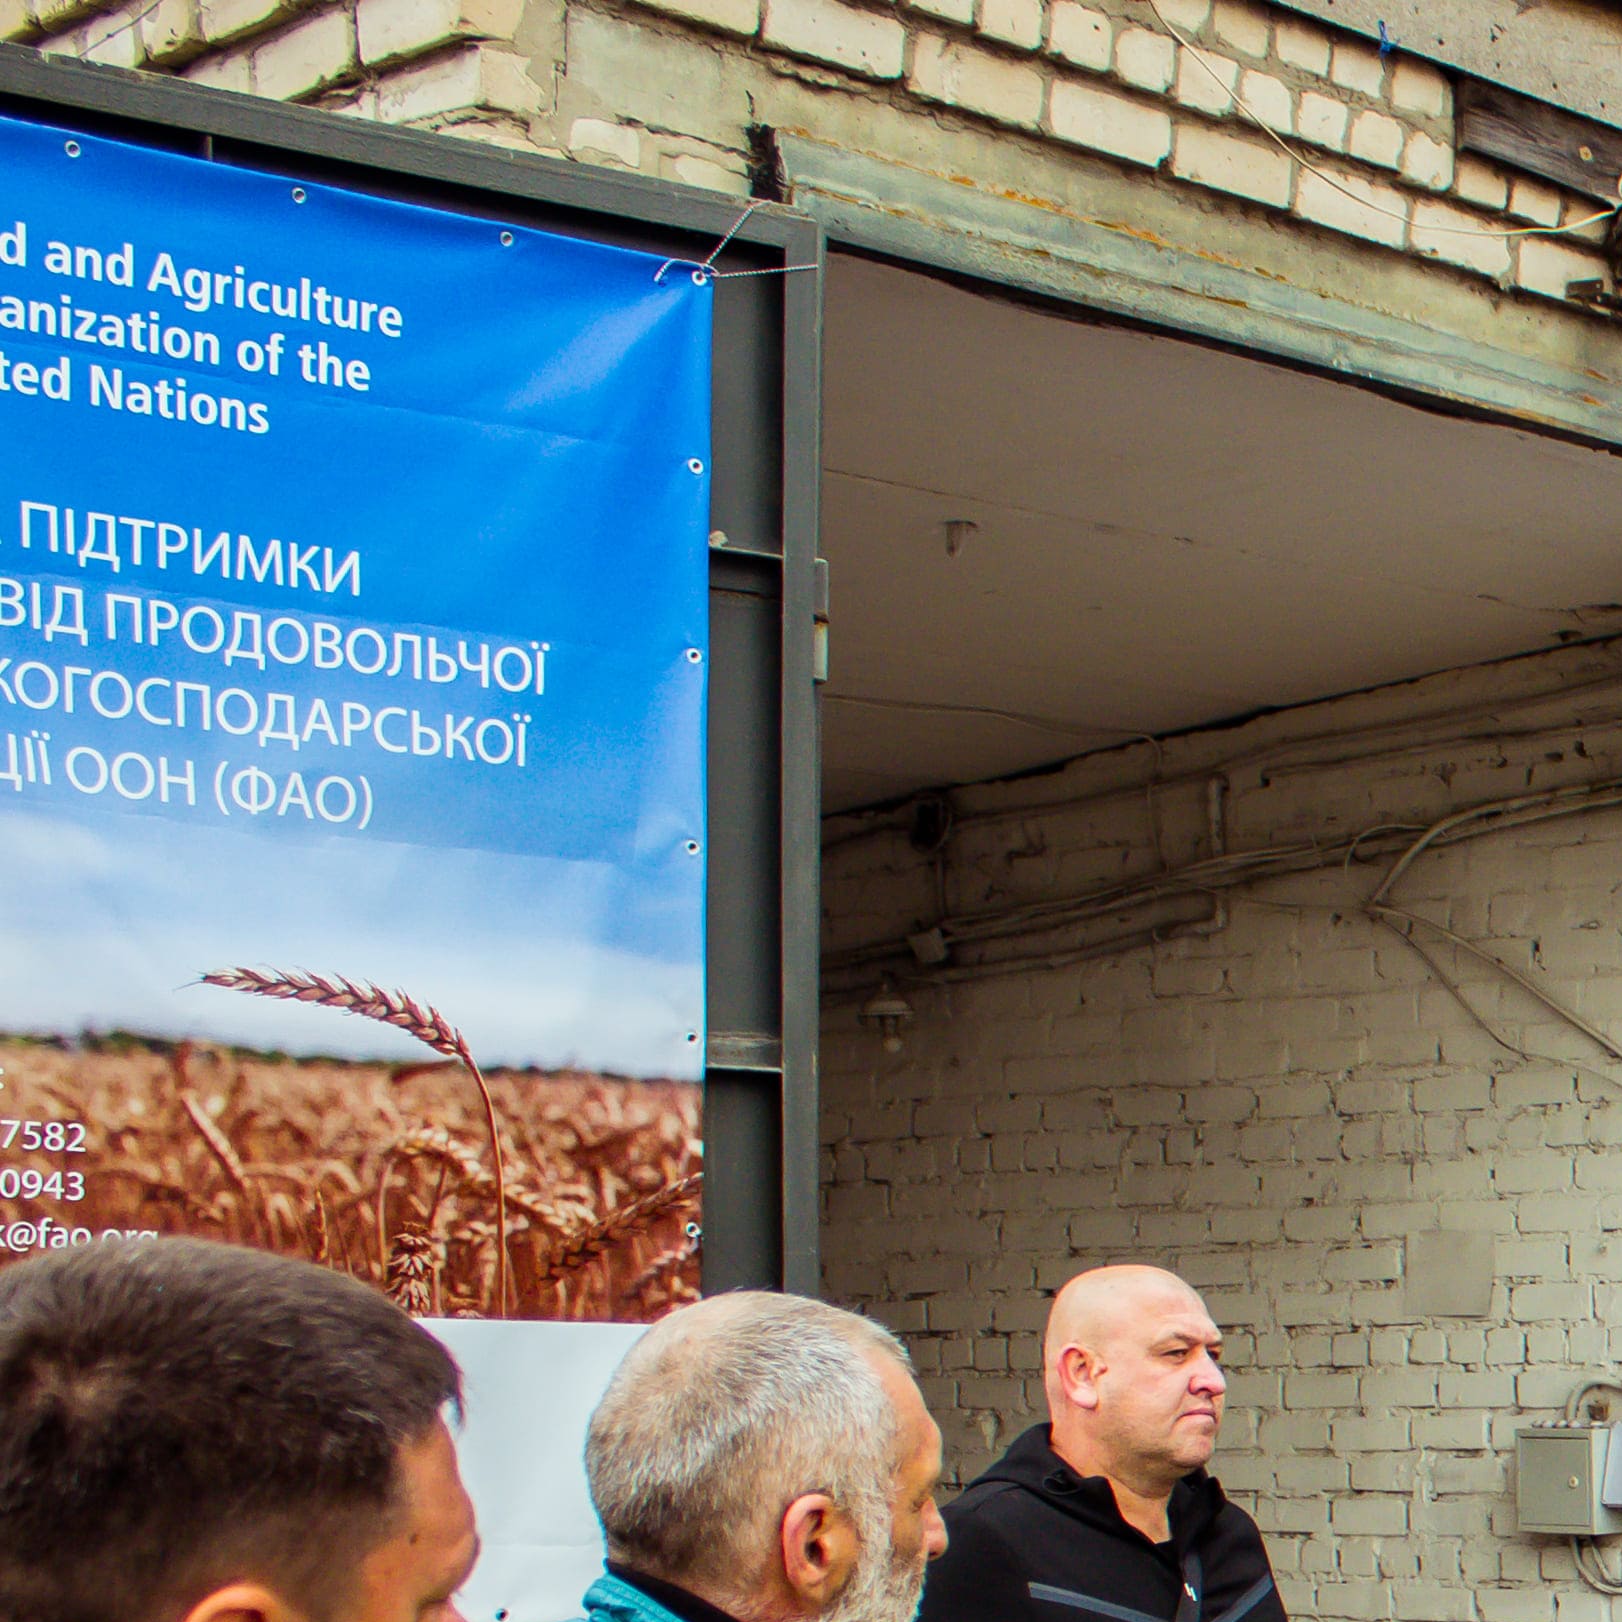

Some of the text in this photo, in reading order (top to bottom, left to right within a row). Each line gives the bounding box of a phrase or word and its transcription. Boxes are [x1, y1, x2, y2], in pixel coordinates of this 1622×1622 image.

[44, 241, 133, 287] and
[147, 252, 403, 338] Agriculture
[90, 364, 270, 433] Nations
[236, 332, 284, 375] of
[297, 341, 370, 391] the
[20, 500, 360, 597] ПІДТРИМКИ
[105, 593, 551, 696] ПРОДОВОЛЬЧОЇ
[66, 747, 194, 805] ООН
[214, 761, 371, 829] (ФАО)
[0, 1119, 86, 1152] 7582
[0, 1169, 86, 1201] 0943
